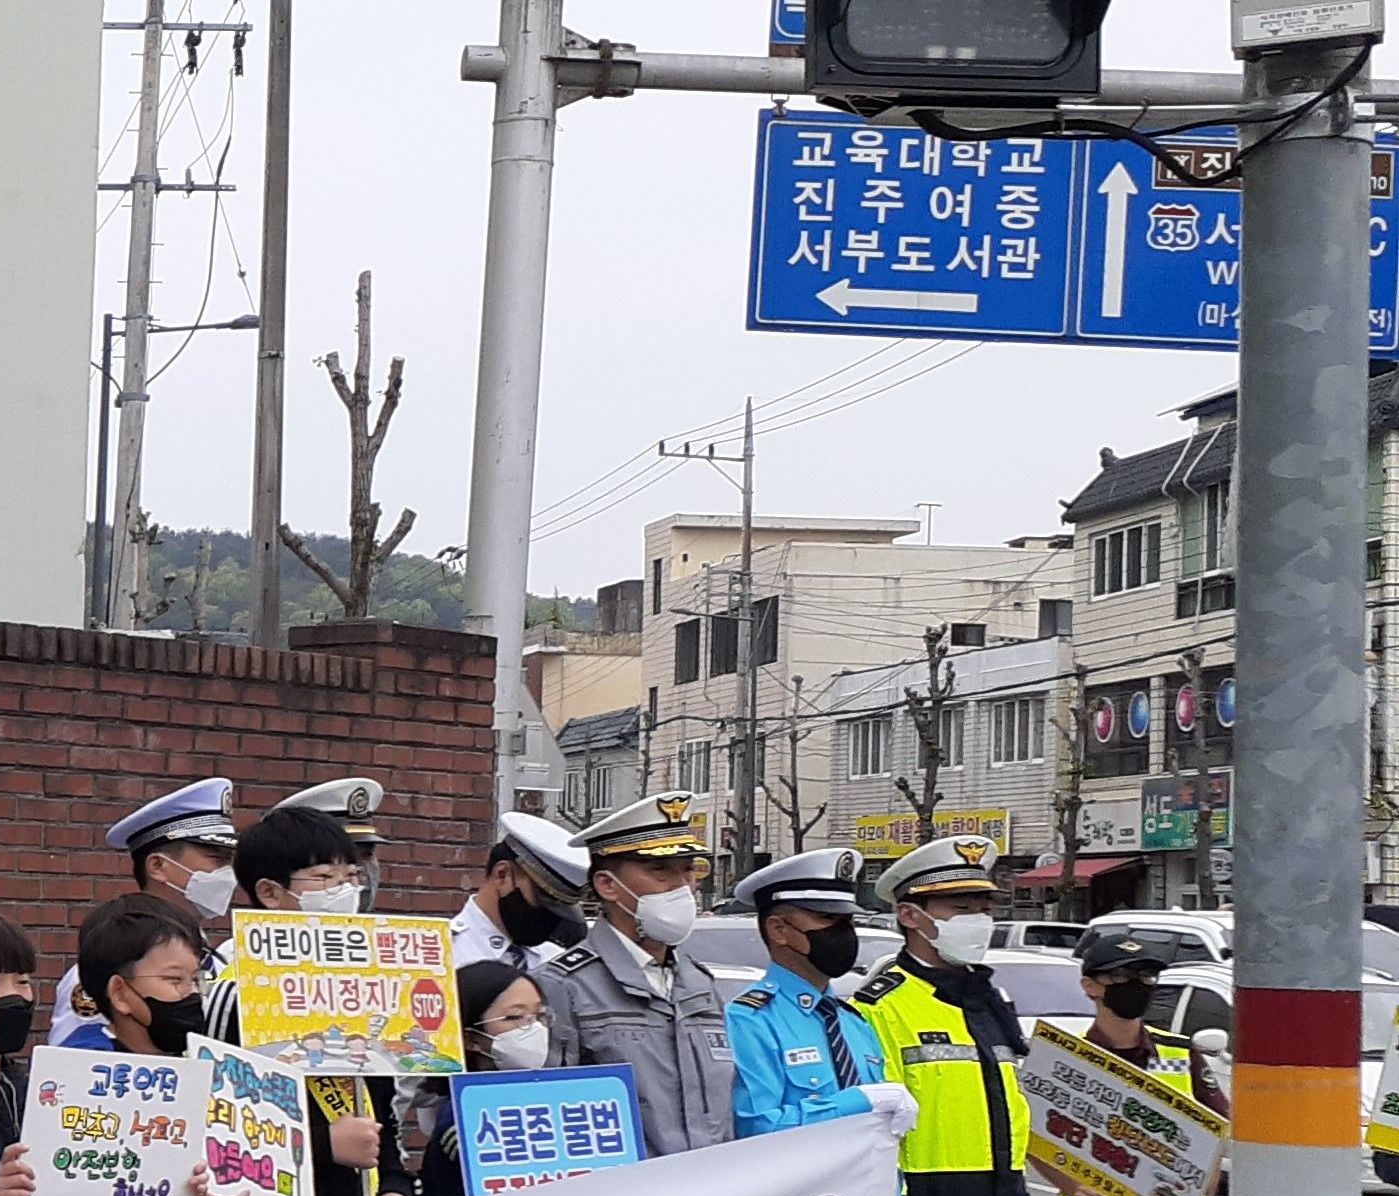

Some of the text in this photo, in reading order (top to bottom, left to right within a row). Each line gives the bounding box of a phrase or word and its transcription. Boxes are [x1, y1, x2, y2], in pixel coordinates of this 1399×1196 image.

[793, 131, 1046, 176] 교육대학교
[1157, 219, 1192, 245] 35
[788, 229, 1041, 280] 서부도서관
[249, 926, 441, 966] 어린이들은 빨간불
[283, 977, 398, 1012] 일시정지!
[412, 993, 443, 1018] STOP
[477, 1101, 624, 1163] 스쿨존 불법
